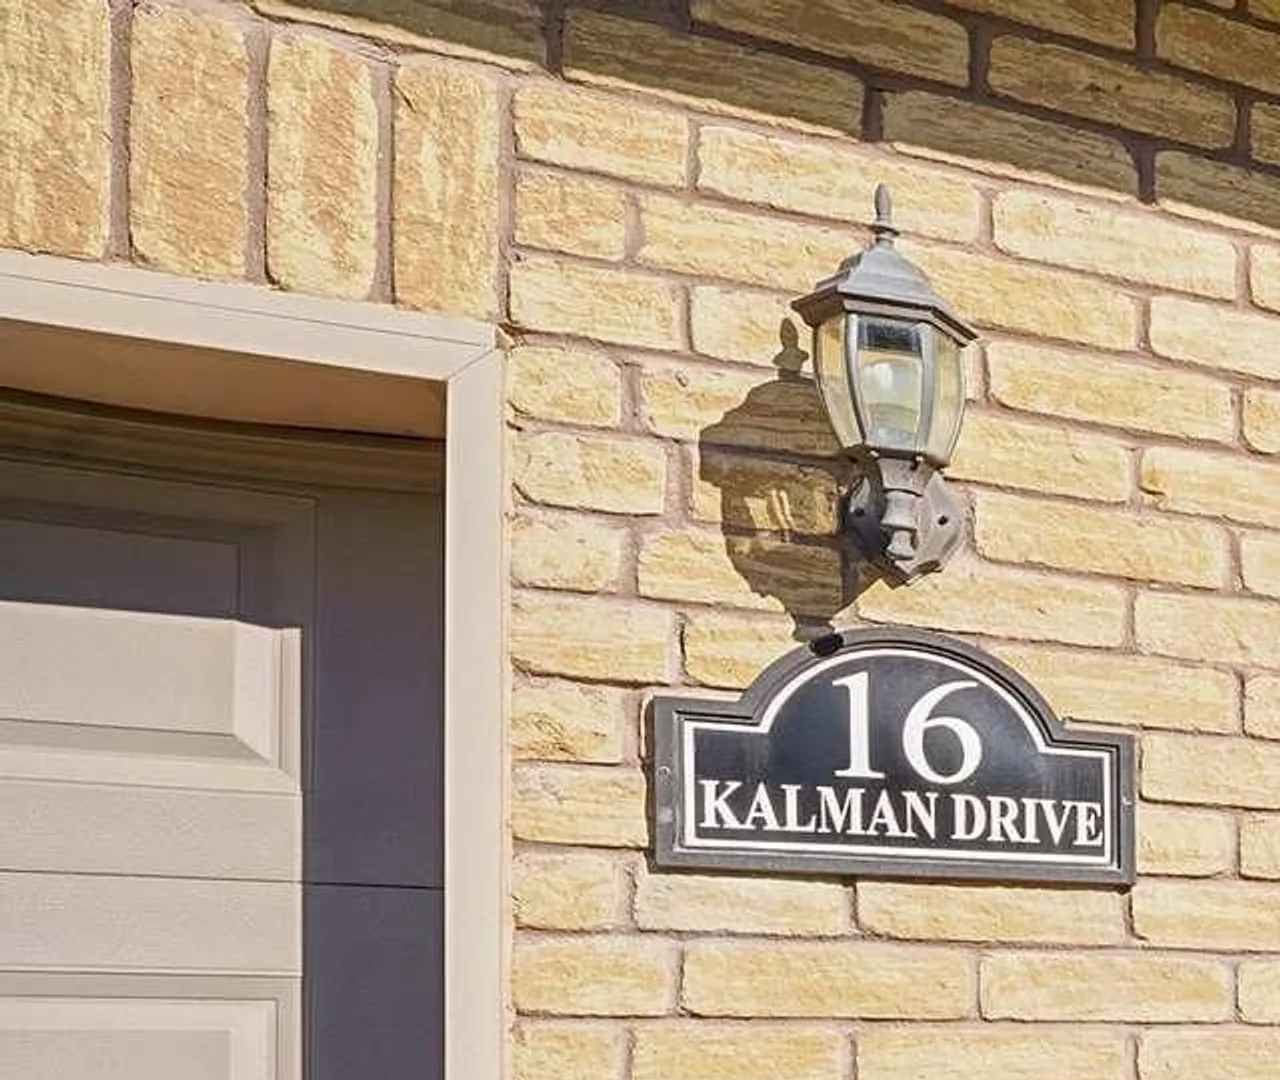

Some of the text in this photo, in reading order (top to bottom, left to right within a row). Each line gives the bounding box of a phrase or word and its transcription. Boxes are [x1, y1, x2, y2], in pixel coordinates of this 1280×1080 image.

[832, 671, 983, 785] 16
[700, 779, 1104, 847] KALMAN DRIVE
